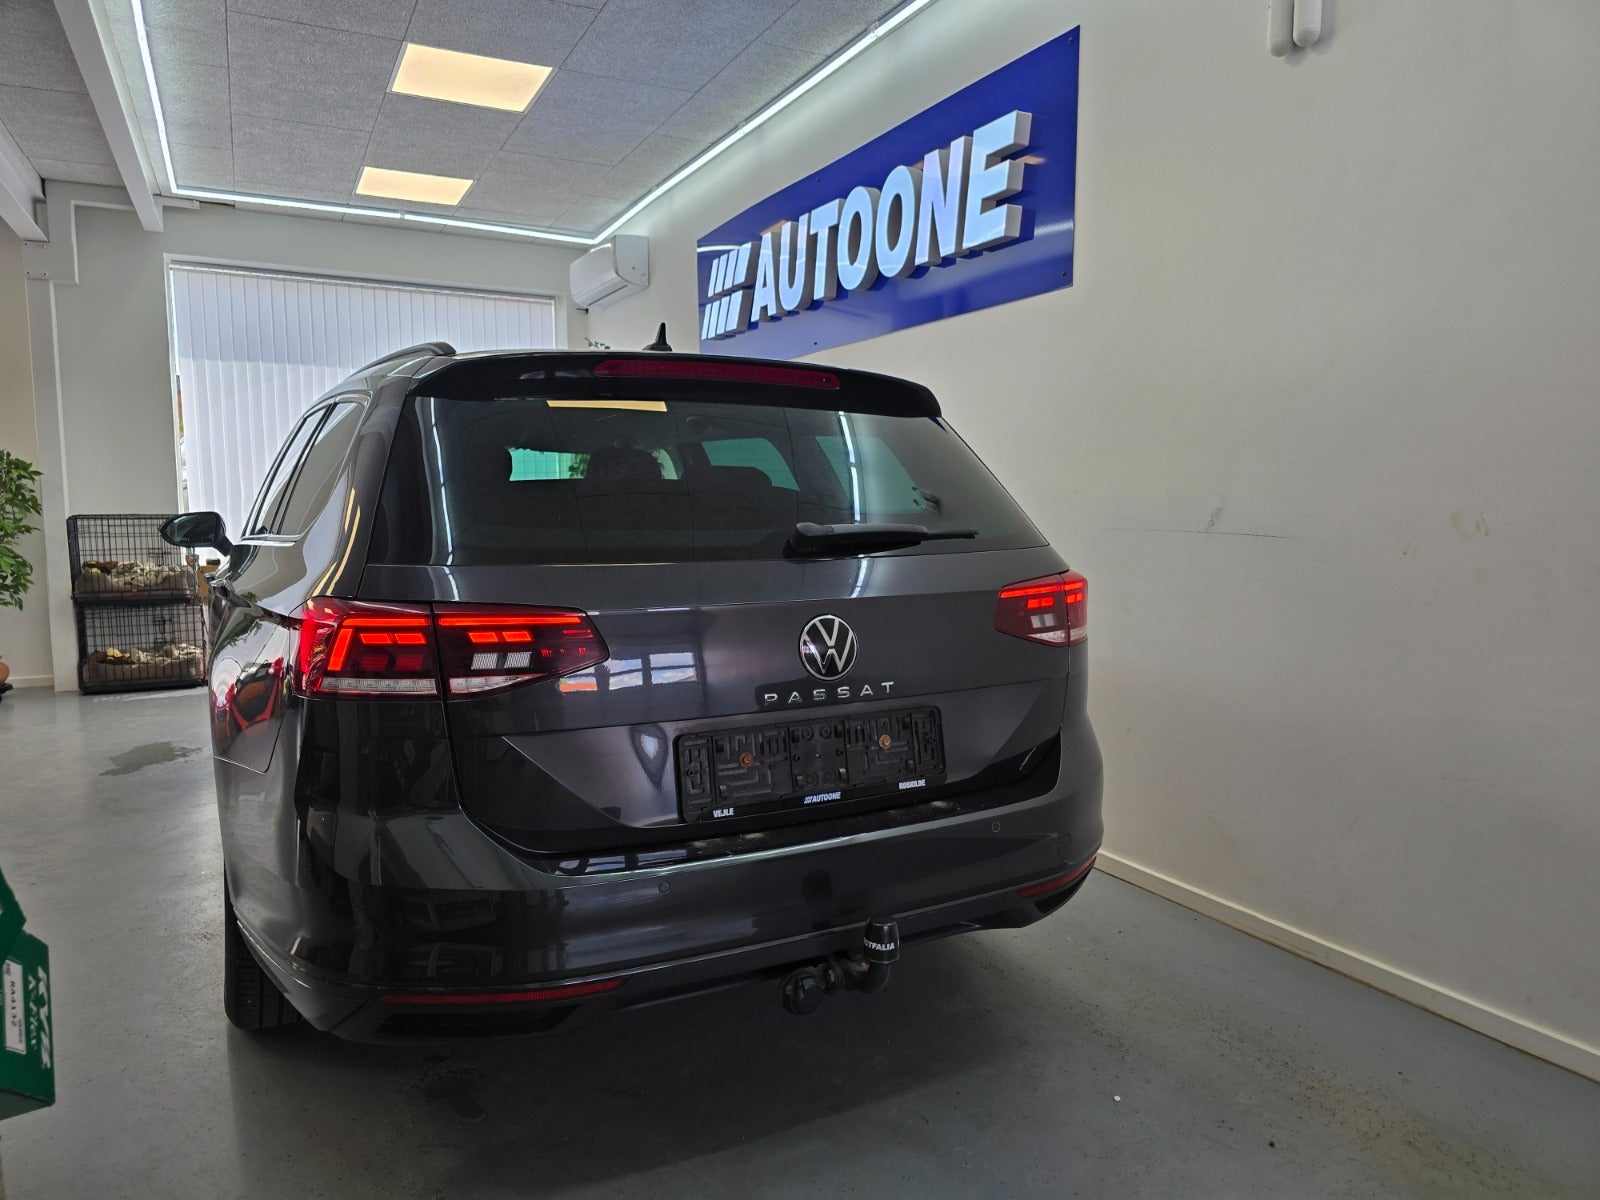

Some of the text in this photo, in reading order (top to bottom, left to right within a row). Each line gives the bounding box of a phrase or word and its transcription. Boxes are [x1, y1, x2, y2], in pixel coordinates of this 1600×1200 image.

[751, 110, 1031, 323] AUTOONE
[764, 681, 895, 705] PASSAT
[713, 807, 735, 818] VEJLE
[812, 791, 842, 804] AUTOONE
